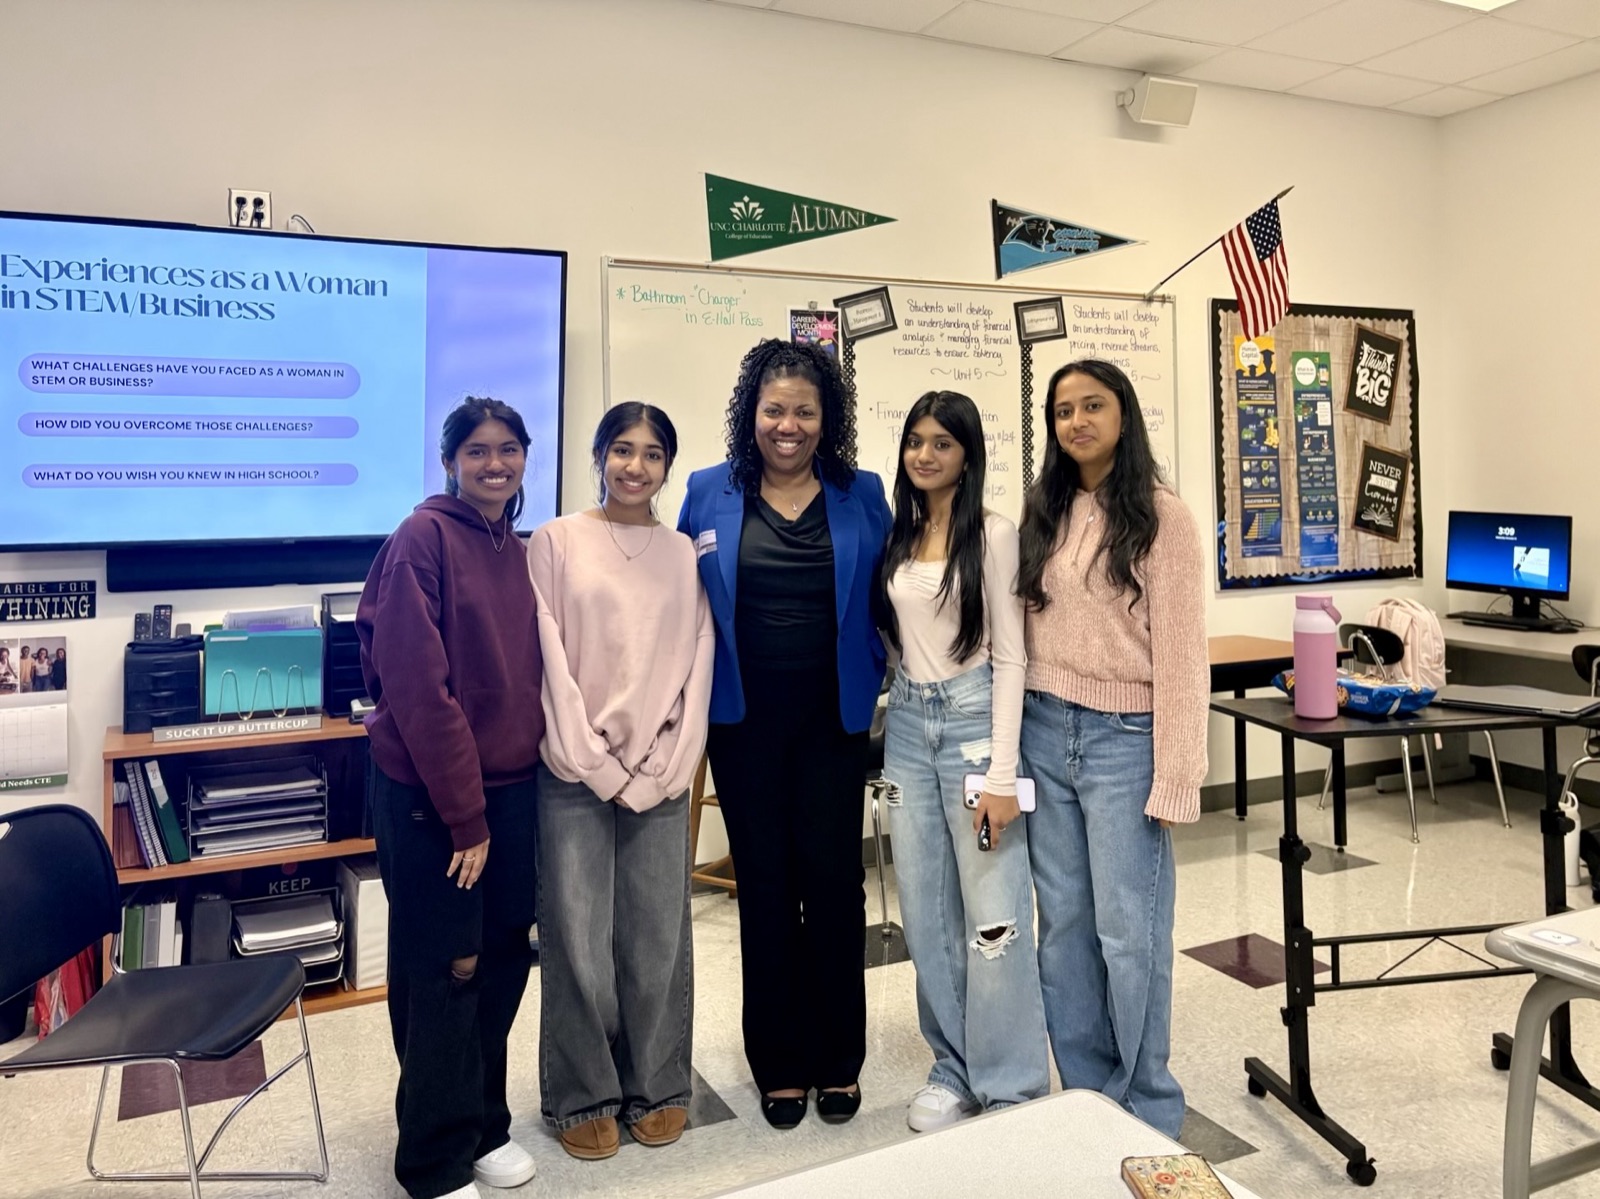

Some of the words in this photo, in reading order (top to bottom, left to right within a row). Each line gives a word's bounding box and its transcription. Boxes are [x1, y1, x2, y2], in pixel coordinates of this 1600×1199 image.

[788, 202, 868, 234] ALUMNI
[711, 222, 731, 231] UNC
[732, 222, 787, 232] CHARLOTTE
[1, 254, 206, 289] Experiences
[210, 270, 246, 290] as
[251, 272, 269, 291] a
[274, 270, 388, 297] Woman
[1, 284, 30, 309] in
[36, 287, 276, 321] STEM/Business
[630, 285, 687, 305] Bathroom
[907, 299, 944, 313] Students
[947, 302, 962, 313] will
[966, 302, 993, 319] develop
[1073, 304, 1110, 320] Students
[1114, 310, 1128, 321] will
[1133, 309, 1160, 327] develop
[685, 311, 698, 324] in
[702, 311, 735, 326] E-Hall
[739, 311, 764, 327] Pass
[791, 315, 817, 323] CAREER
[791, 322, 837, 331] DEVELOPMENT
[904, 318, 914, 327] an
[917, 318, 971, 337] understanding
[972, 320, 980, 331] of
[983, 318, 1012, 332] financial
[797, 329, 822, 338] MONTH
[902, 332, 935, 347] analysis
[947, 336, 980, 350] managing
[983, 334, 1012, 345] financial
[1072, 325, 1082, 334] an
[1083, 325, 1136, 345] understanding
[1140, 328, 1150, 340] of
[1101, 343, 1129, 352] revenue
[893, 347, 930, 356] resources
[934, 348, 942, 357] to
[943, 349, 969, 358] ensure
[973, 348, 1003, 367] solvency
[1364, 347, 1388, 373] Think
[31, 360, 69, 370] WHAT
[73, 361, 153, 373] CHALLENGES
[156, 364, 188, 374] HAVE
[192, 365, 216, 374] YOU
[219, 366, 256, 376] FACED
[259, 367, 273, 376] AS
[276, 368, 284, 376] A
[287, 368, 331, 377] WOMAN
[334, 369, 344, 378] IN
[953, 368, 971, 381] Unit
[973, 367, 983, 380] 5
[31, 375, 65, 385] STEM
[69, 376, 86, 386] OR
[89, 377, 154, 387] BUSINESS?
[35, 420, 67, 429] HOW
[71, 420, 92, 429] DID
[95, 420, 121, 430] YOU
[124, 421, 192, 430] OVERCOME
[195, 421, 232, 431] THOSE
[235, 422, 313, 432] CHALLENGES?
[988, 460, 1009, 472] class
[1369, 460, 1402, 480] NEVER
[33, 471, 72, 481] WHAT
[75, 471, 94, 481] DO
[97, 471, 122, 480] YOU
[125, 471, 157, 480] WISH
[160, 470, 184, 480] YOU
[187, 470, 222, 480] KNEW
[224, 470, 235, 479] IN
[238, 470, 266, 479] HIGH
[268, 470, 319, 479] SCHOOL?
[1375, 477, 1393, 488] STOP
[1498, 526, 1515, 536] 3:09
[3, 583, 47, 594] ARGE
[59, 582, 89, 592] FOR
[165, 728, 200, 739] SUCK
[203, 727, 215, 736] IT
[218, 725, 235, 735] UP
[238, 719, 309, 733] BUTTERCUP
[8, 779, 33, 788] Needs
[269, 877, 311, 895] KEEP
